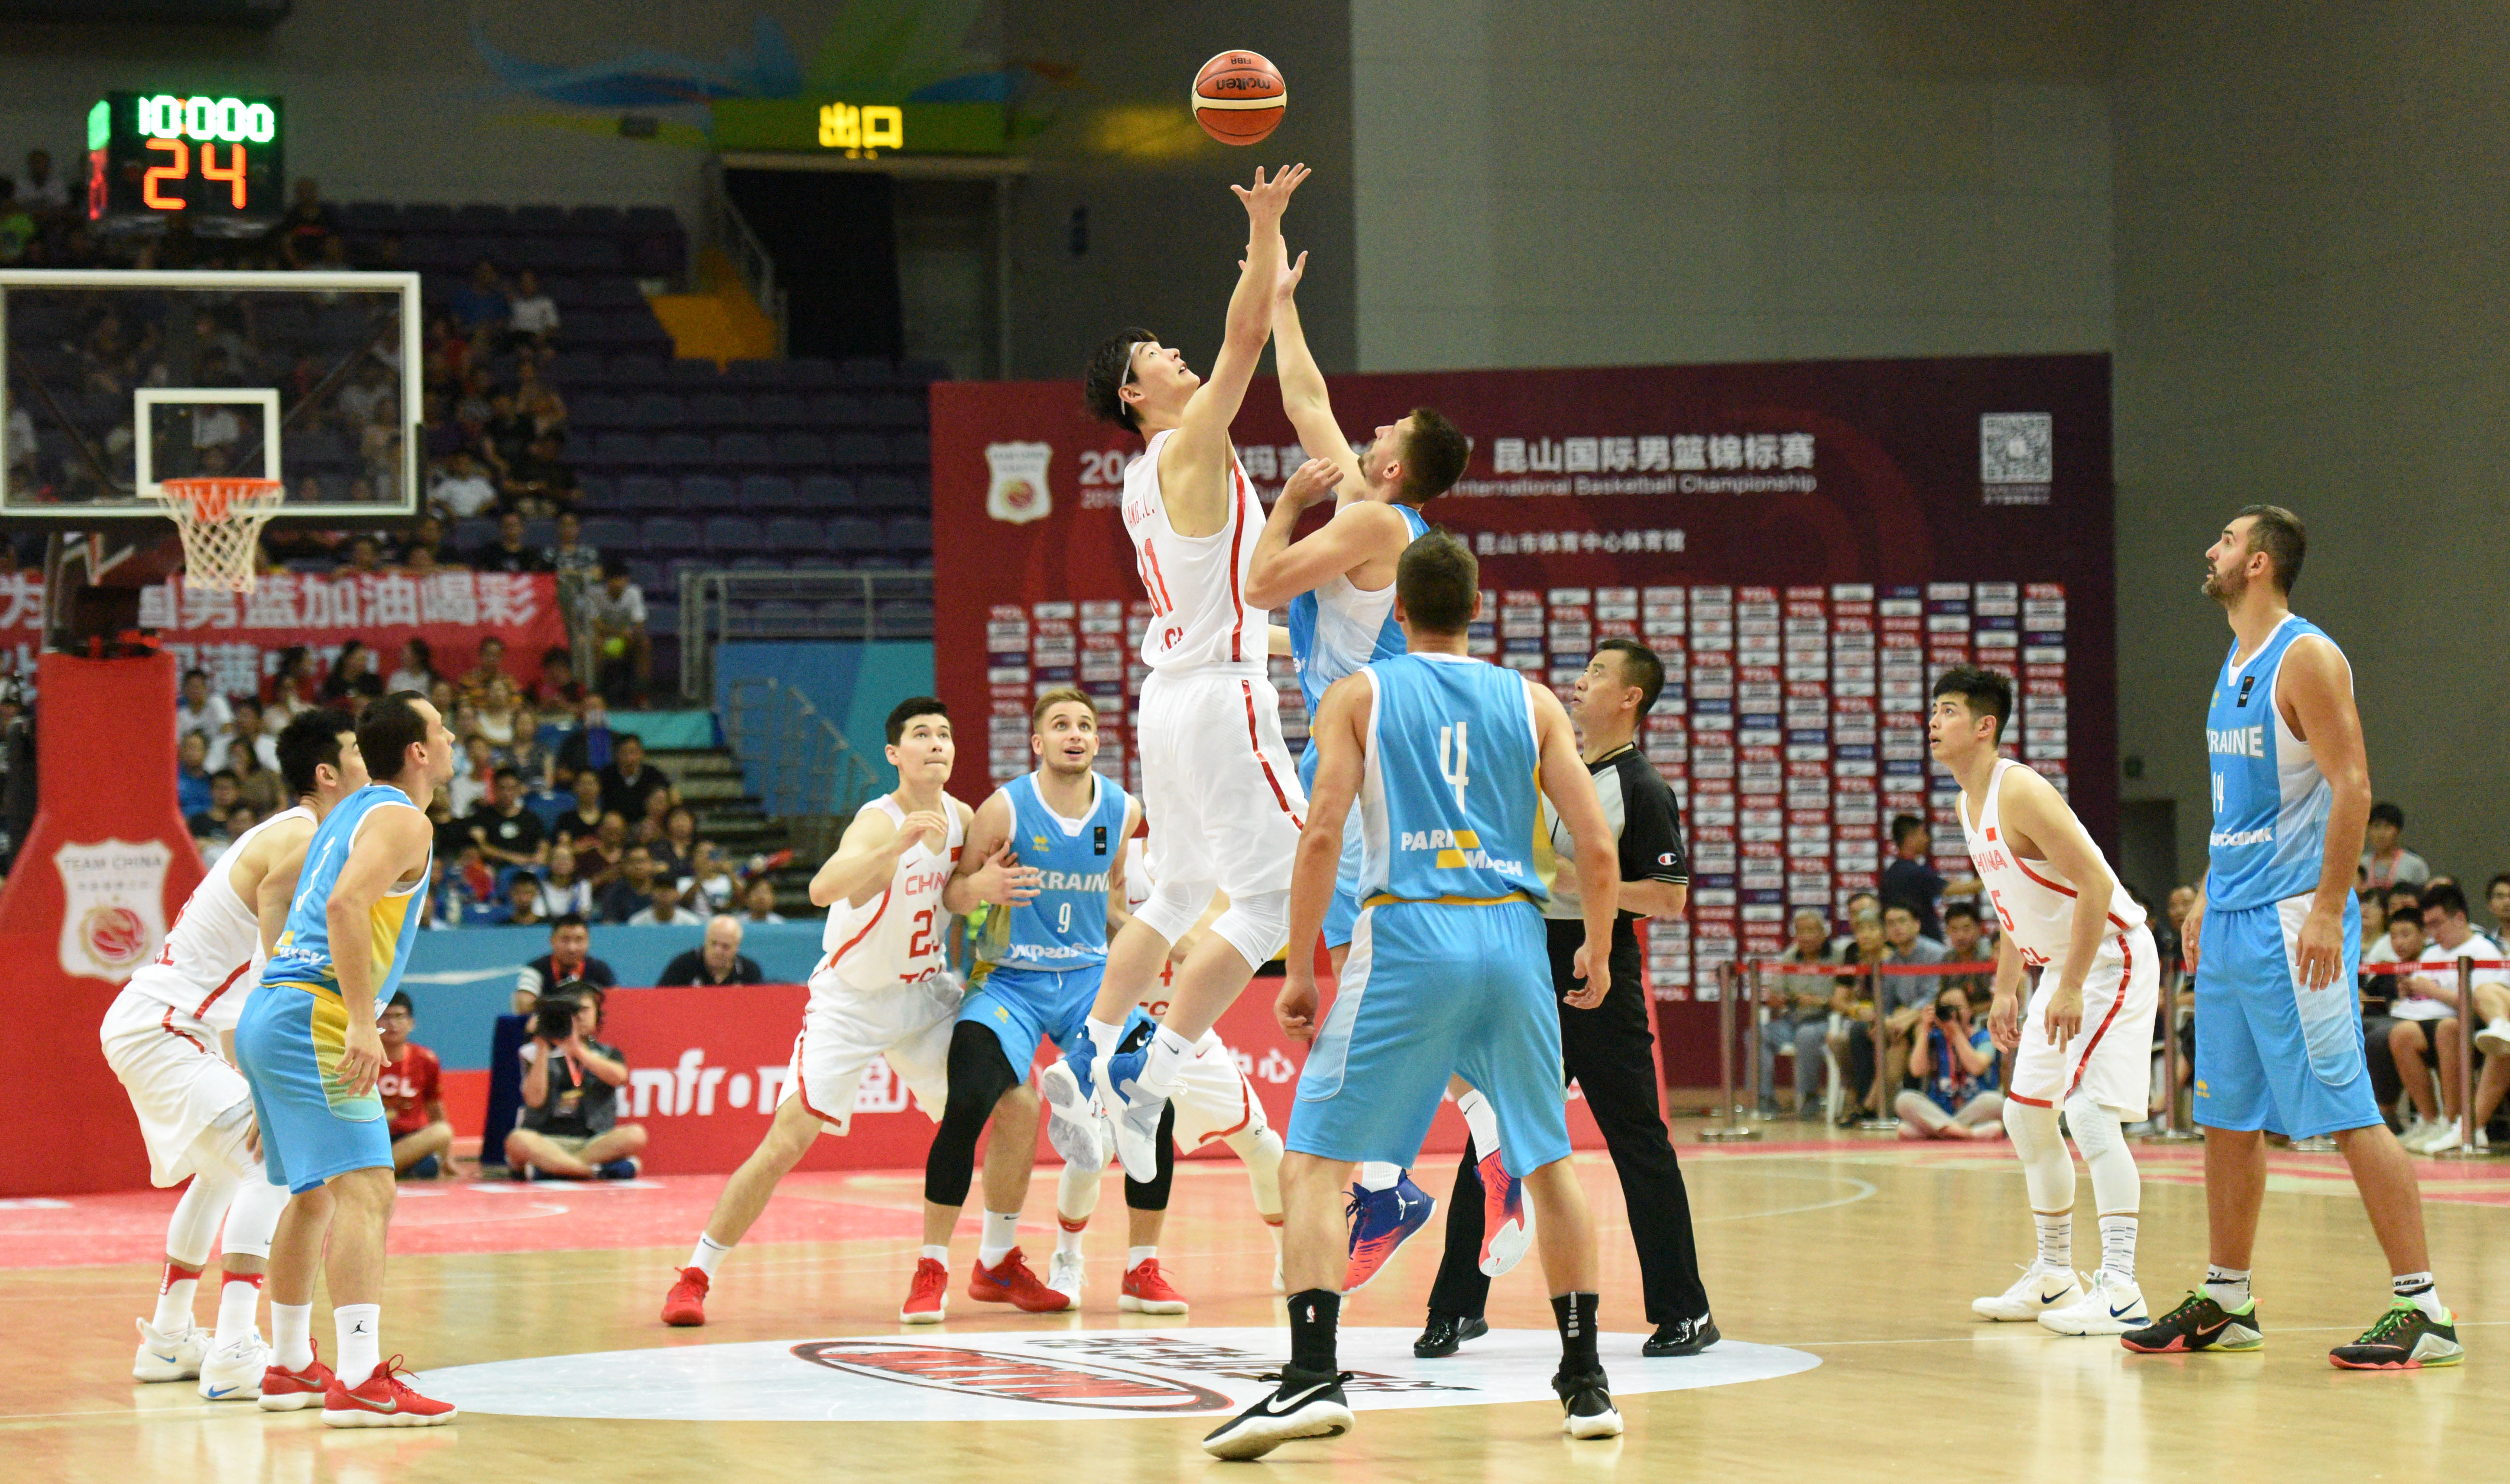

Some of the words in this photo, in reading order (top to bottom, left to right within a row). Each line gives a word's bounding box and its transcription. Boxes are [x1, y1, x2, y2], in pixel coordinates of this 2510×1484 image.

[1216, 78, 1271, 90] molten
[819, 102, 903, 148] 出口
[143, 138, 246, 209] 24
[1441, 722, 1469, 814] 4
[2213, 771, 2224, 813] 14
[1401, 829, 1453, 851] PARI
[1020, 866, 1109, 892] KRAIN
[909, 904, 939, 954] 2
[1057, 903, 1071, 933] 9
[1991, 890, 2014, 932] 5
[2019, 947, 2051, 964] CL
